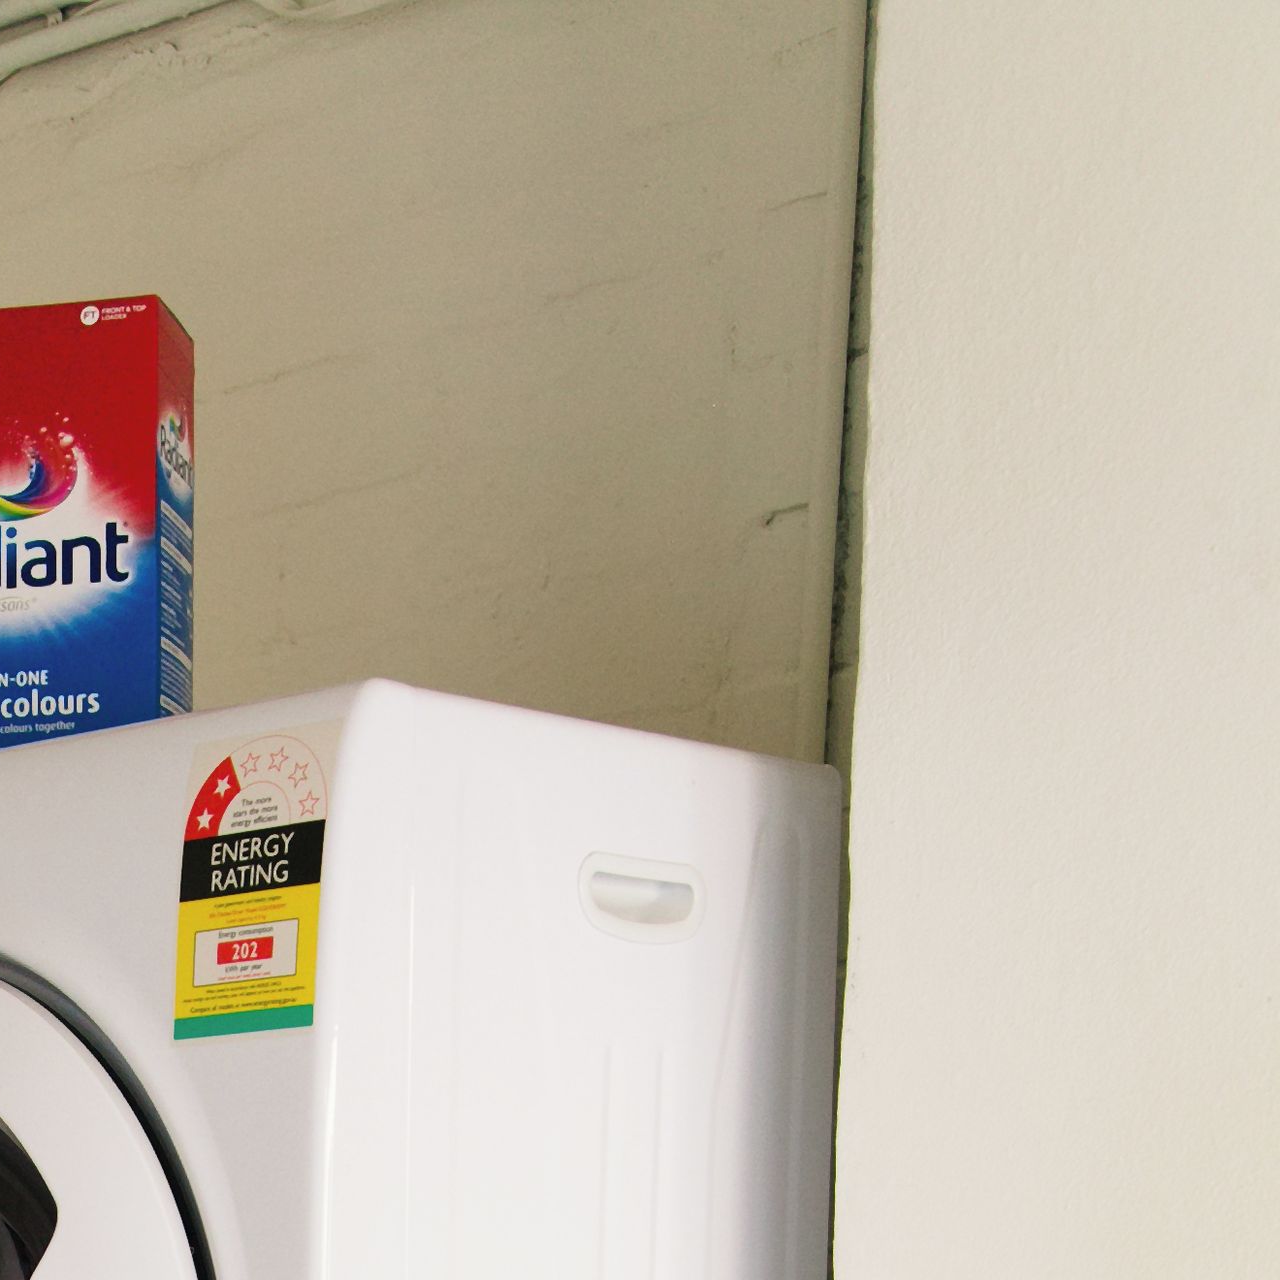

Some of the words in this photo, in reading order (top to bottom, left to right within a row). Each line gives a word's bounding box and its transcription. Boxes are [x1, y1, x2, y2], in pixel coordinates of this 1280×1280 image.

[102, 306, 125, 314] FRONT
[132, 304, 147, 312] TOP
[0, 688, 100, 718] colours
[0, 722, 33, 734] colours
[35, 720, 76, 735] together
[210, 832, 295, 866] ENERGY
[210, 860, 289, 892] RATING
[218, 931, 237, 939] Energy
[232, 941, 258, 960] 202
